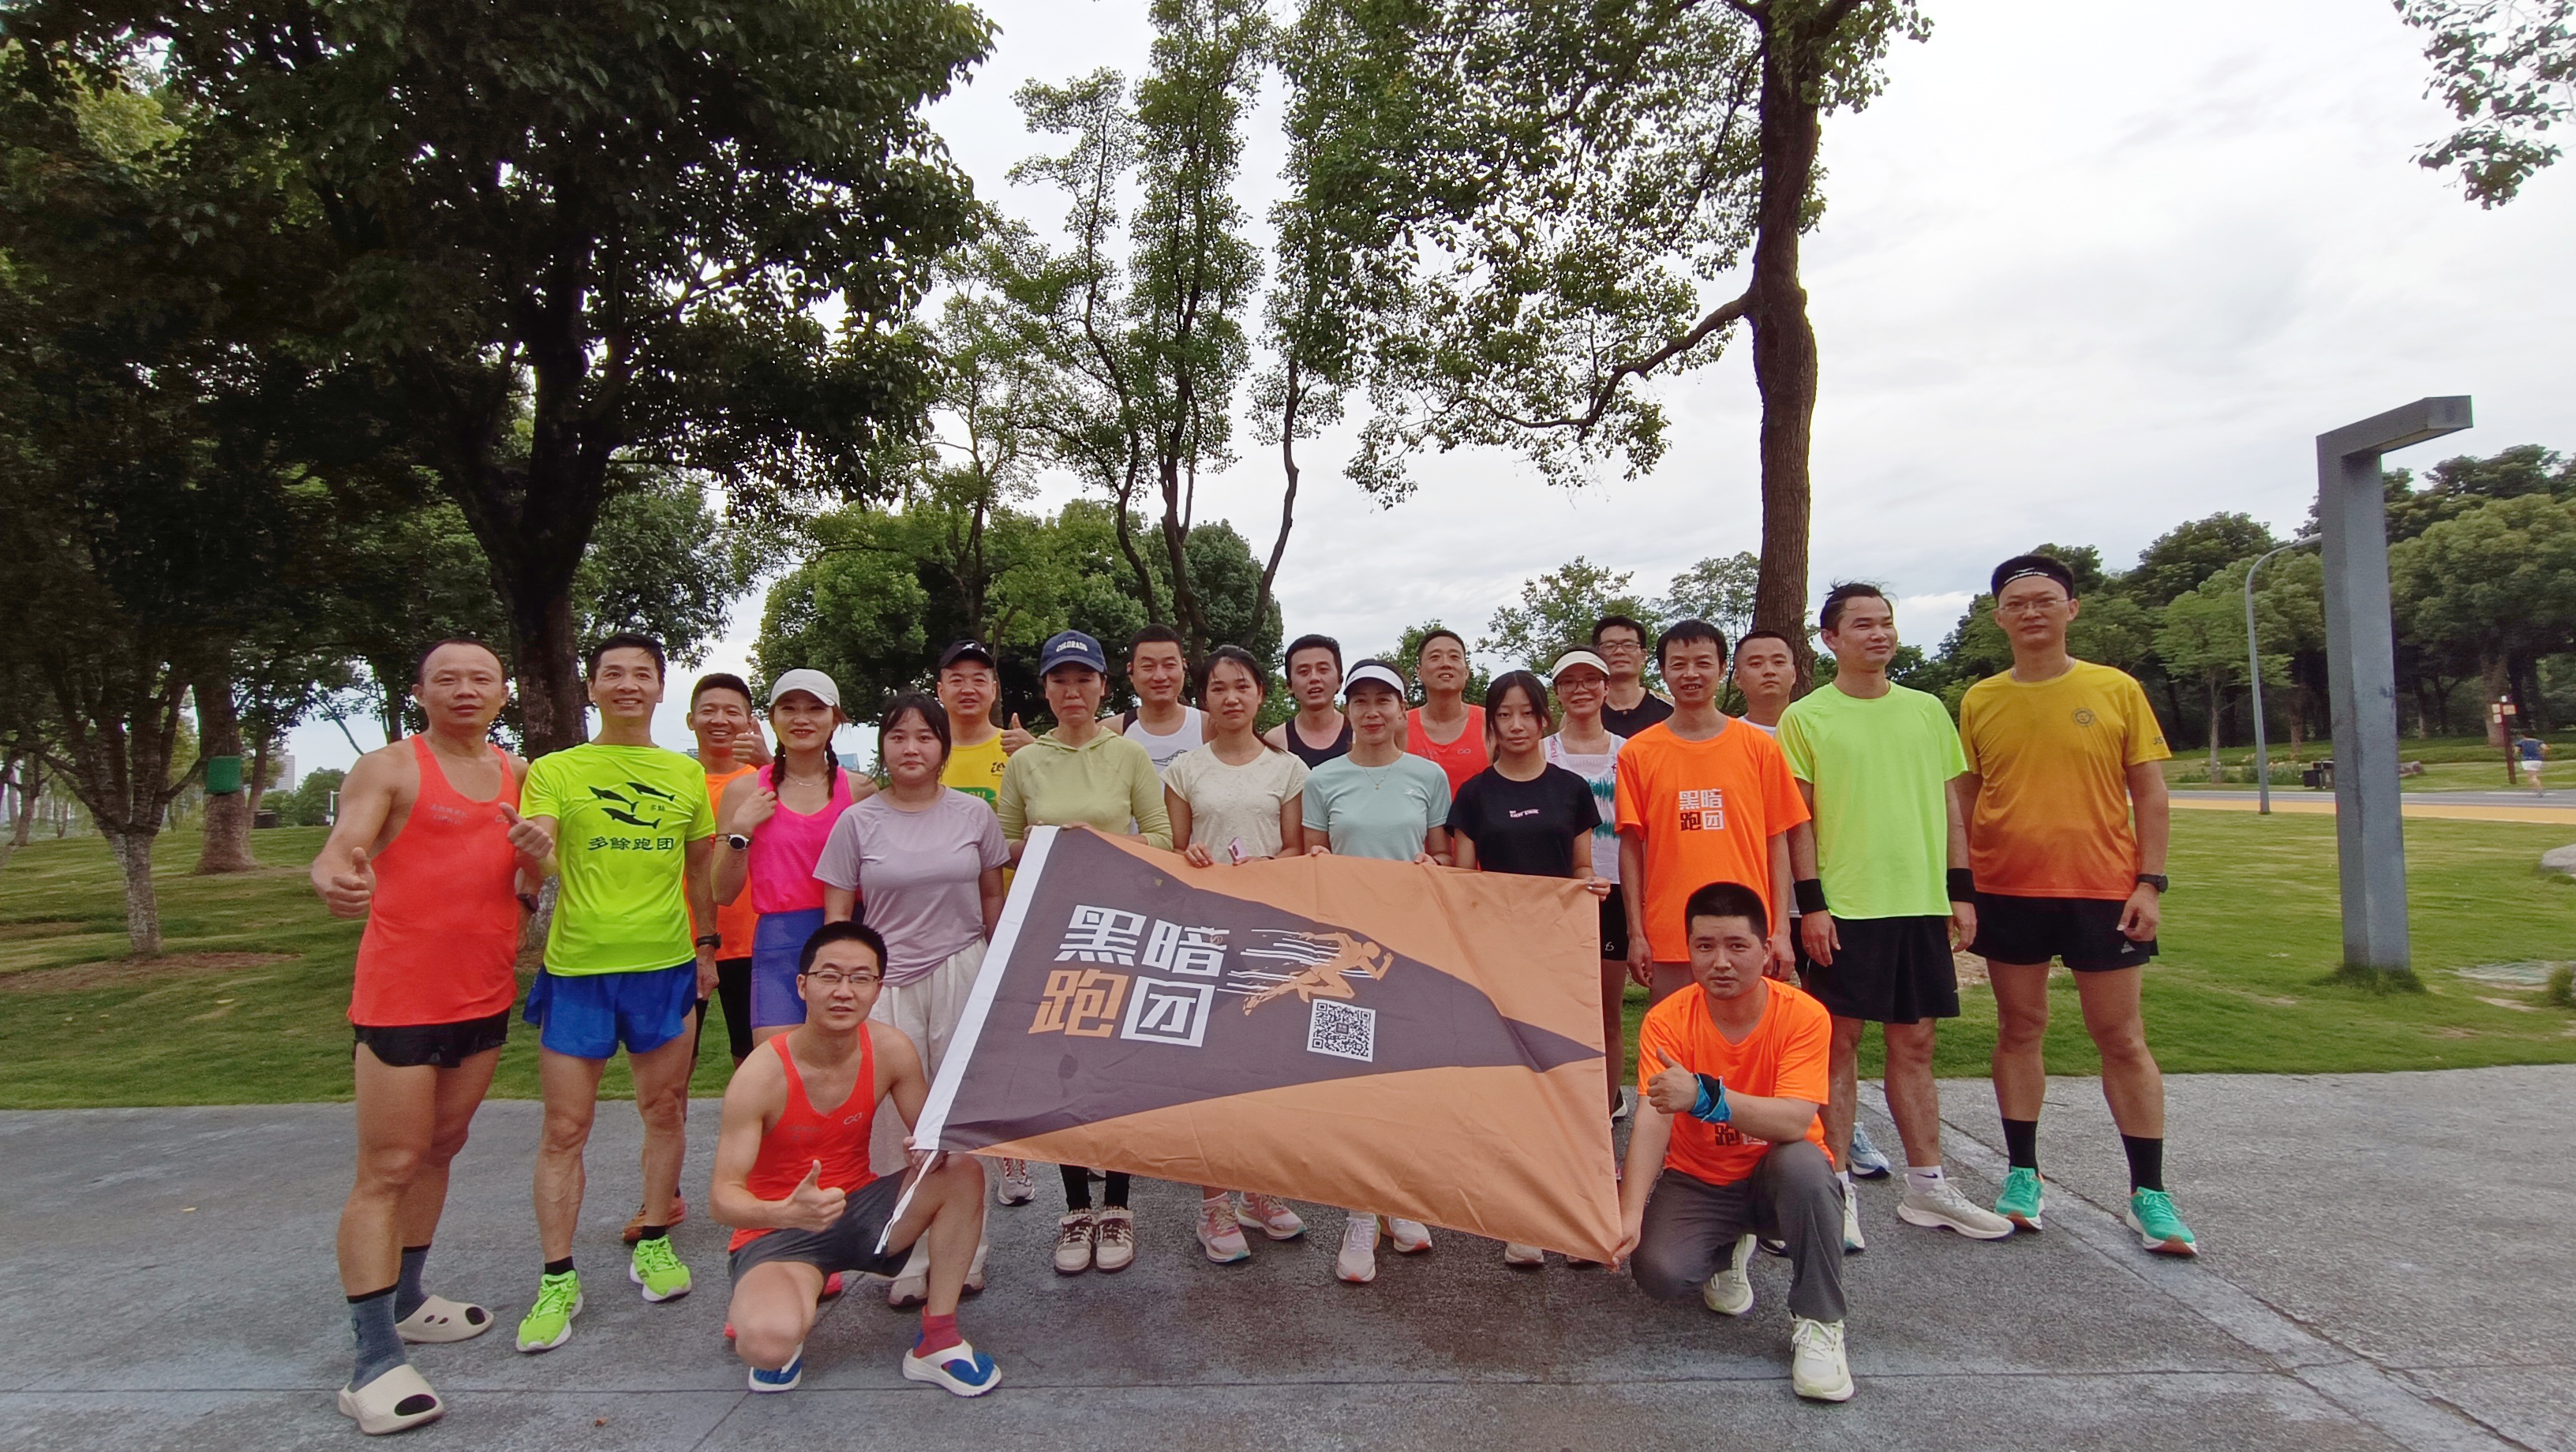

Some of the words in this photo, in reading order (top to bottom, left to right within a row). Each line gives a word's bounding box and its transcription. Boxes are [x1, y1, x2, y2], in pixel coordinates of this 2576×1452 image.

[1679, 788, 1723, 810] 黑暗
[1679, 810, 1724, 831] 跑团
[1054, 904, 1230, 977] 黑暗
[1028, 968, 1215, 1047] 跑团
